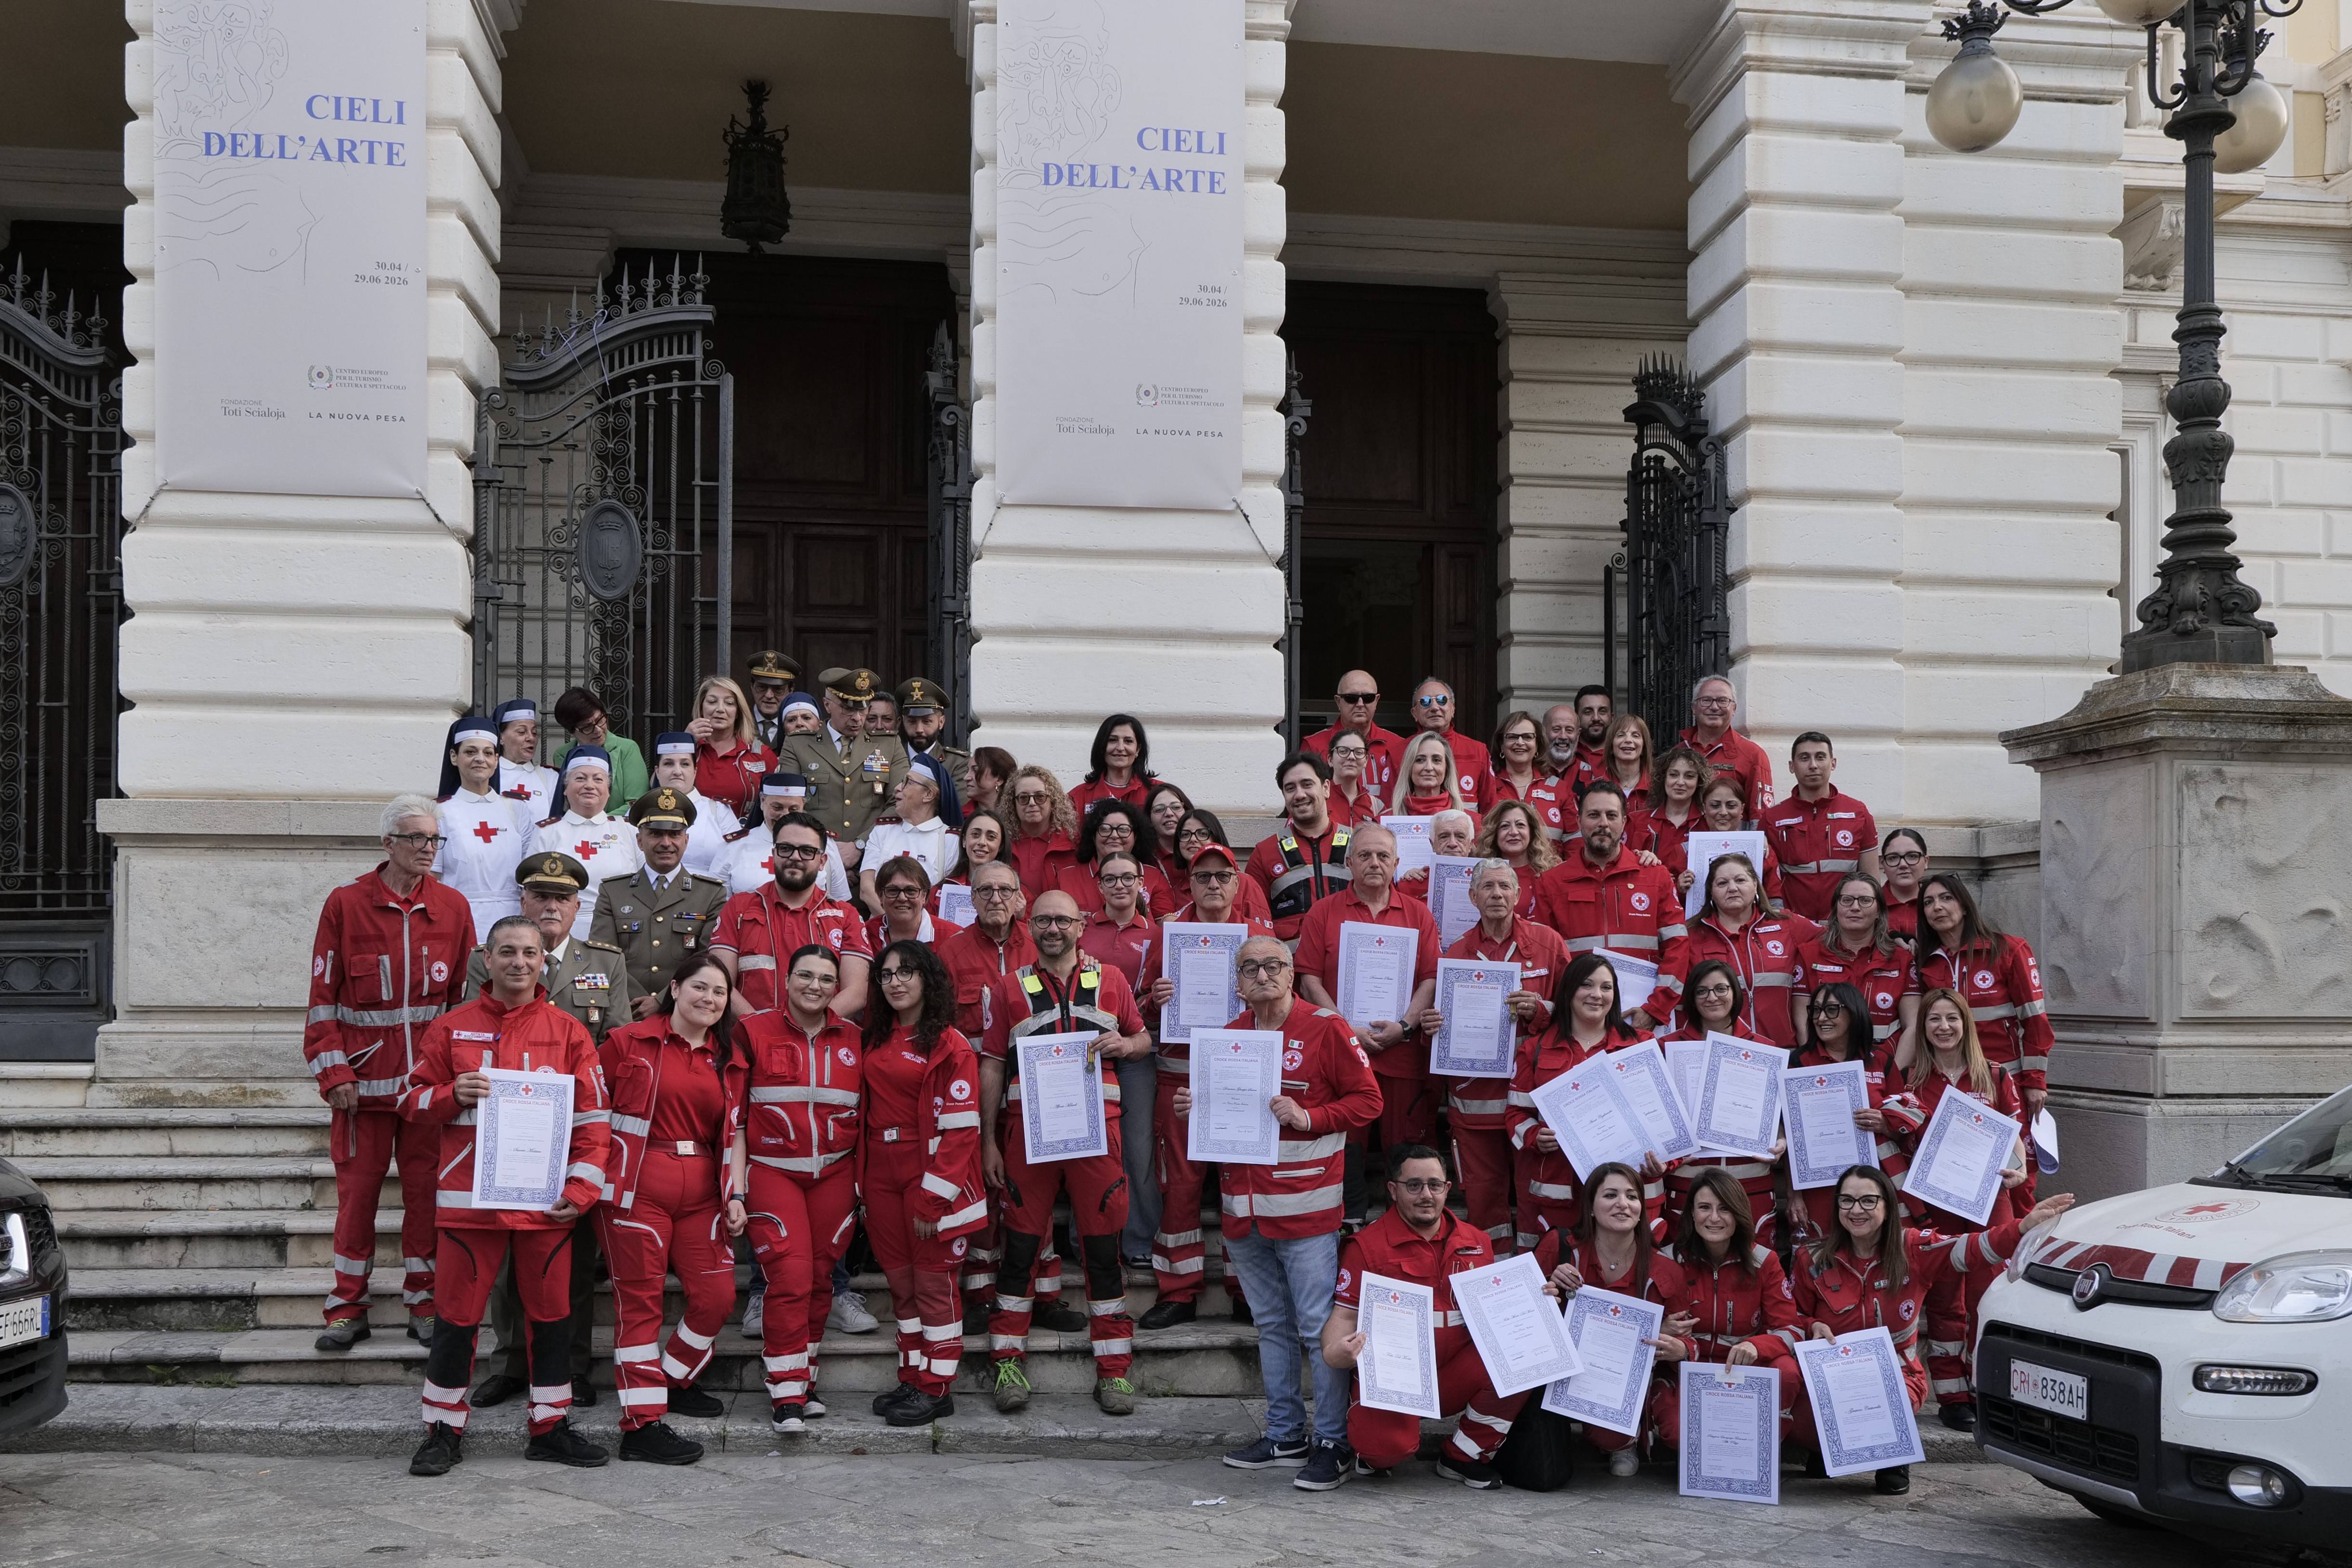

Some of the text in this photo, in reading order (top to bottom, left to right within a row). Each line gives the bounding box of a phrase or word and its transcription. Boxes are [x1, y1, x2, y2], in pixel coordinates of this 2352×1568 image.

[305, 94, 407, 125] CIELI
[1136, 127, 1226, 156] CIELI
[202, 132, 407, 167] DELL'ARTE
[1042, 162, 1226, 195] DELL'ARTE
[374, 261, 402, 272] 30.04
[354, 274, 408, 286] 29.06 2026
[1197, 285, 1223, 294] 30.04
[1179, 296, 1227, 308] 29.06 2026
[221, 406, 286, 421] Toti Scialoja
[1056, 424, 1115, 436] Toti Scialoja
[2163, 1225, 2196, 1239] Italiana
[2077, 1278, 2094, 1293] FIAT
[13, 1306, 40, 1337] 666RL
[2012, 1369, 2084, 1410] CRI 838AH
